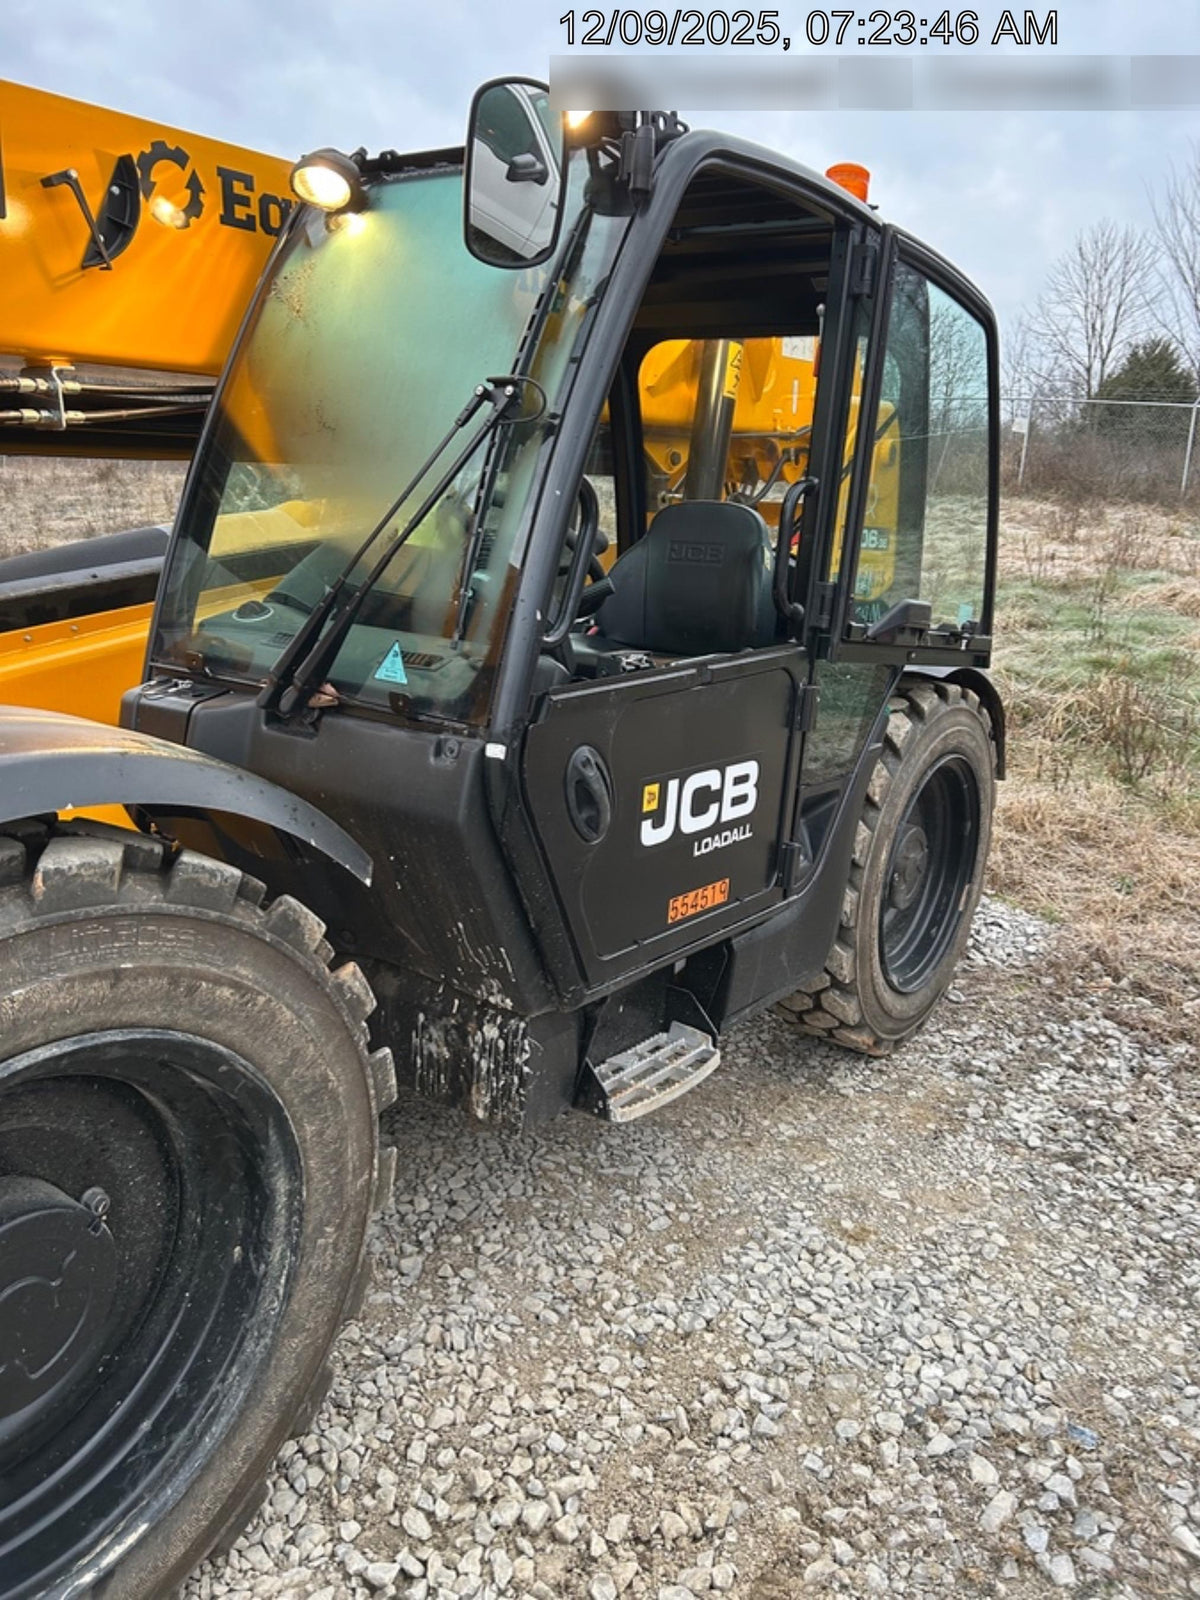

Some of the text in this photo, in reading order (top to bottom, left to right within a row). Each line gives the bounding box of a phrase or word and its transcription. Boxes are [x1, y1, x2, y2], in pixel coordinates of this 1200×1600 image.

[216, 165, 297, 237] Eq
[670, 543, 725, 562] JCB
[641, 759, 760, 848] JCB
[692, 823, 754, 858] LOADALL
[669, 880, 729, 921] 554519
